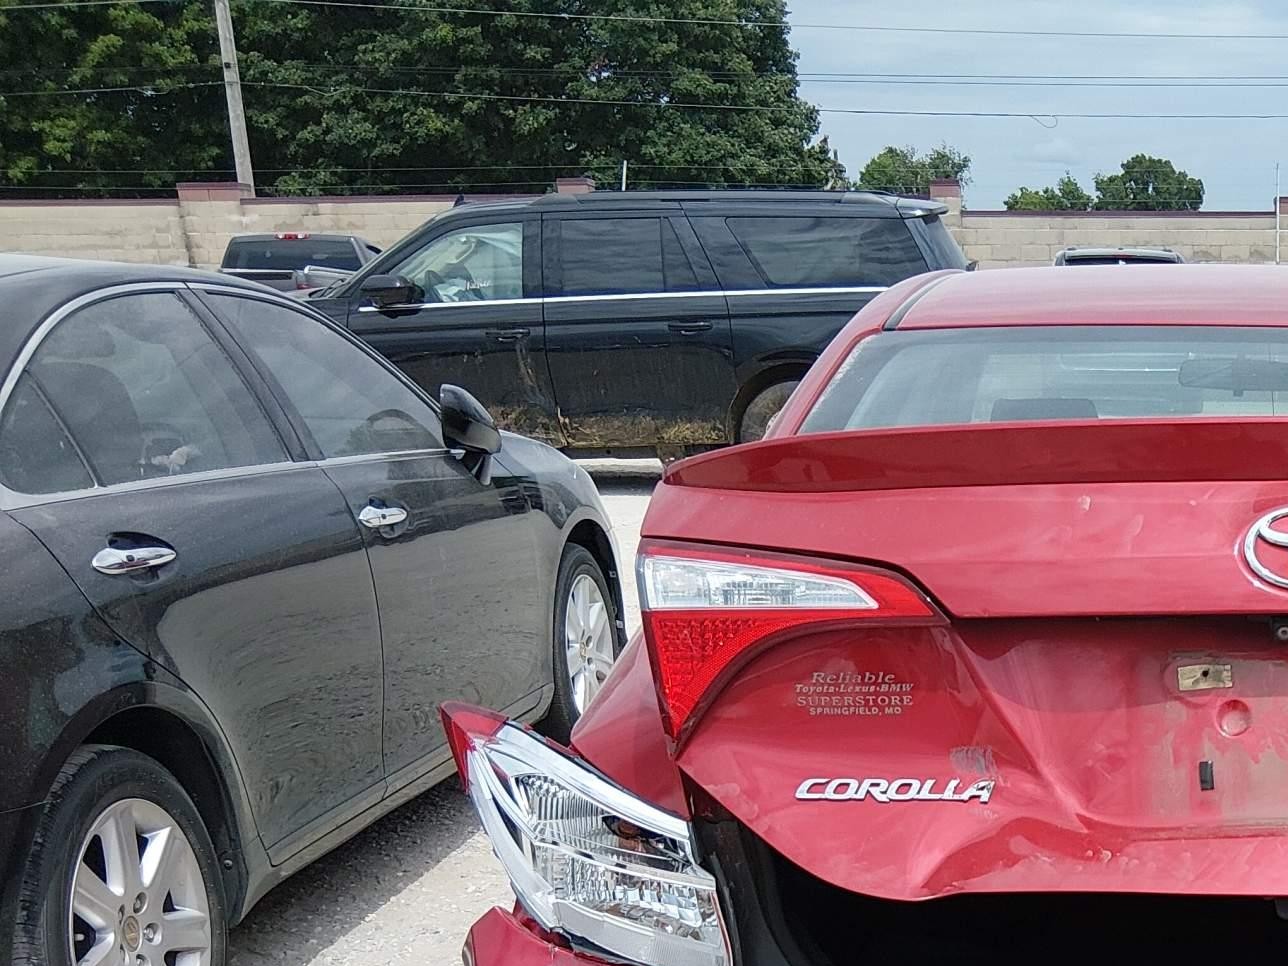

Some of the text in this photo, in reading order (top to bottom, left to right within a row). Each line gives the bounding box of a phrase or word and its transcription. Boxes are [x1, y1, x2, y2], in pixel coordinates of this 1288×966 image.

[812, 671, 896, 683] Reliable
[797, 695, 914, 707] SUPERSTORE
[809, 706, 902, 716] SPRINGFIELD, MO
[795, 778, 996, 804] COROLLA
